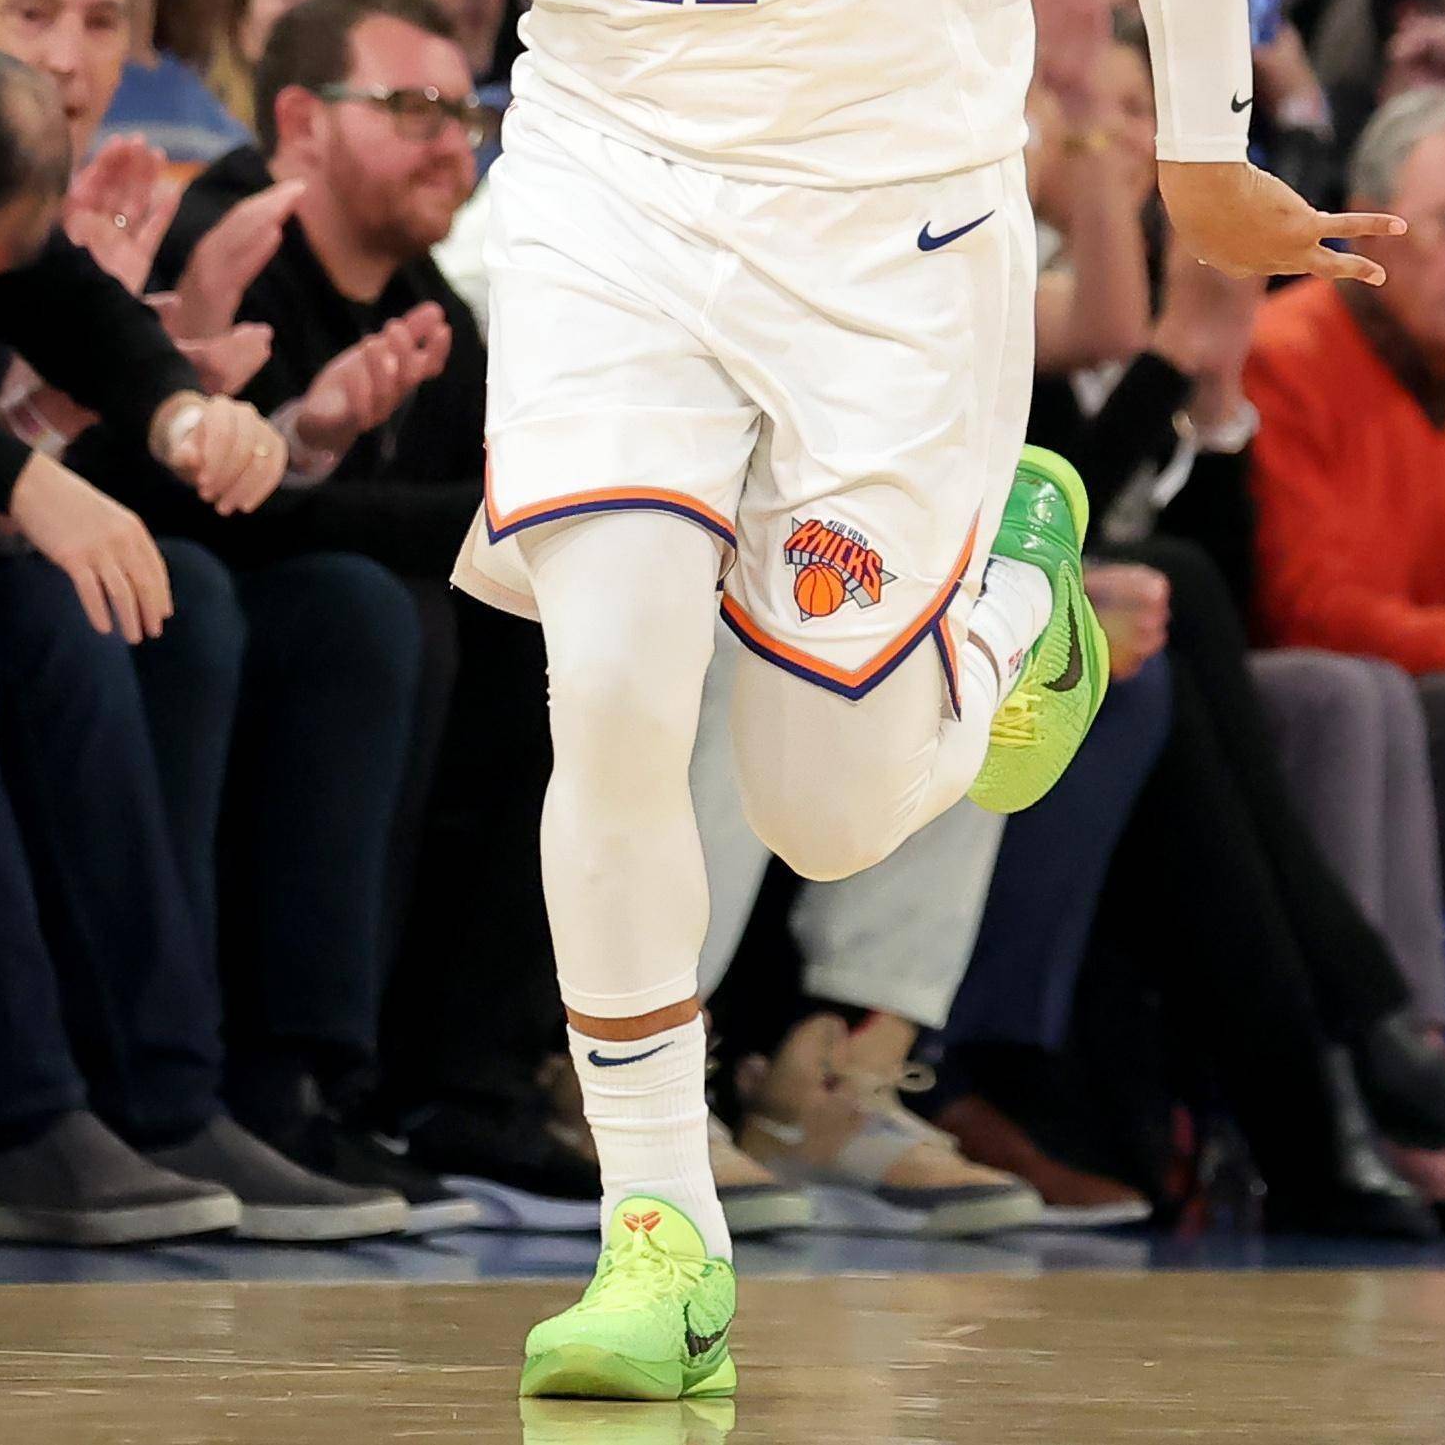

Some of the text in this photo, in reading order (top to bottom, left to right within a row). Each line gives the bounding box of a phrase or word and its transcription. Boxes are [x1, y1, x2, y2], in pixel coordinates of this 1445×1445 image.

[784, 519, 883, 604] KNICKS
[826, 520, 869, 549] NEW YORK
